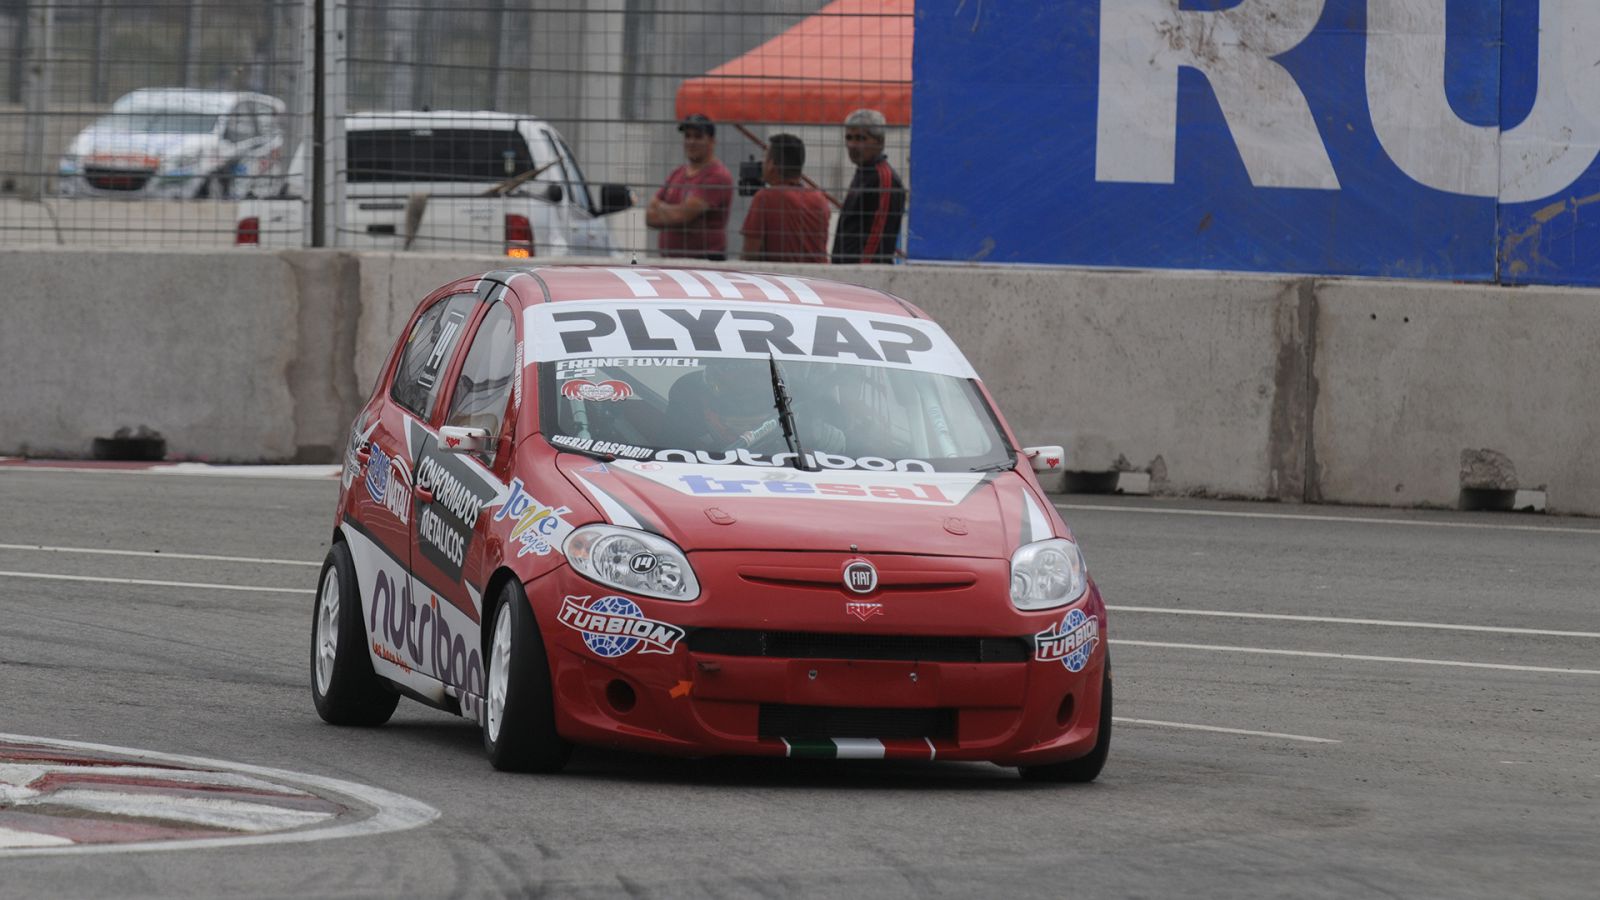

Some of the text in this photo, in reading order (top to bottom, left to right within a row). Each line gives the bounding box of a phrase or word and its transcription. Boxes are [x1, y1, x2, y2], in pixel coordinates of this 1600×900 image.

[606, 268, 824, 305] FIAT
[426, 321, 459, 369] 14
[552, 308, 934, 364] PLYRAP
[556, 358, 699, 371] FRANETOVICH
[556, 368, 596, 380] C2
[551, 434, 593, 453] FUERZA
[655, 448, 935, 473] nutribon
[416, 455, 483, 529] CONFORMADOS
[679, 474, 955, 505] tresal
[420, 507, 465, 568] METALICOS
[634, 557, 653, 569] 14
[851, 571, 871, 586] FIAT
[562, 606, 675, 645] TURBION
[1041, 619, 1097, 658] TURBION
[371, 569, 483, 724] nutribon
